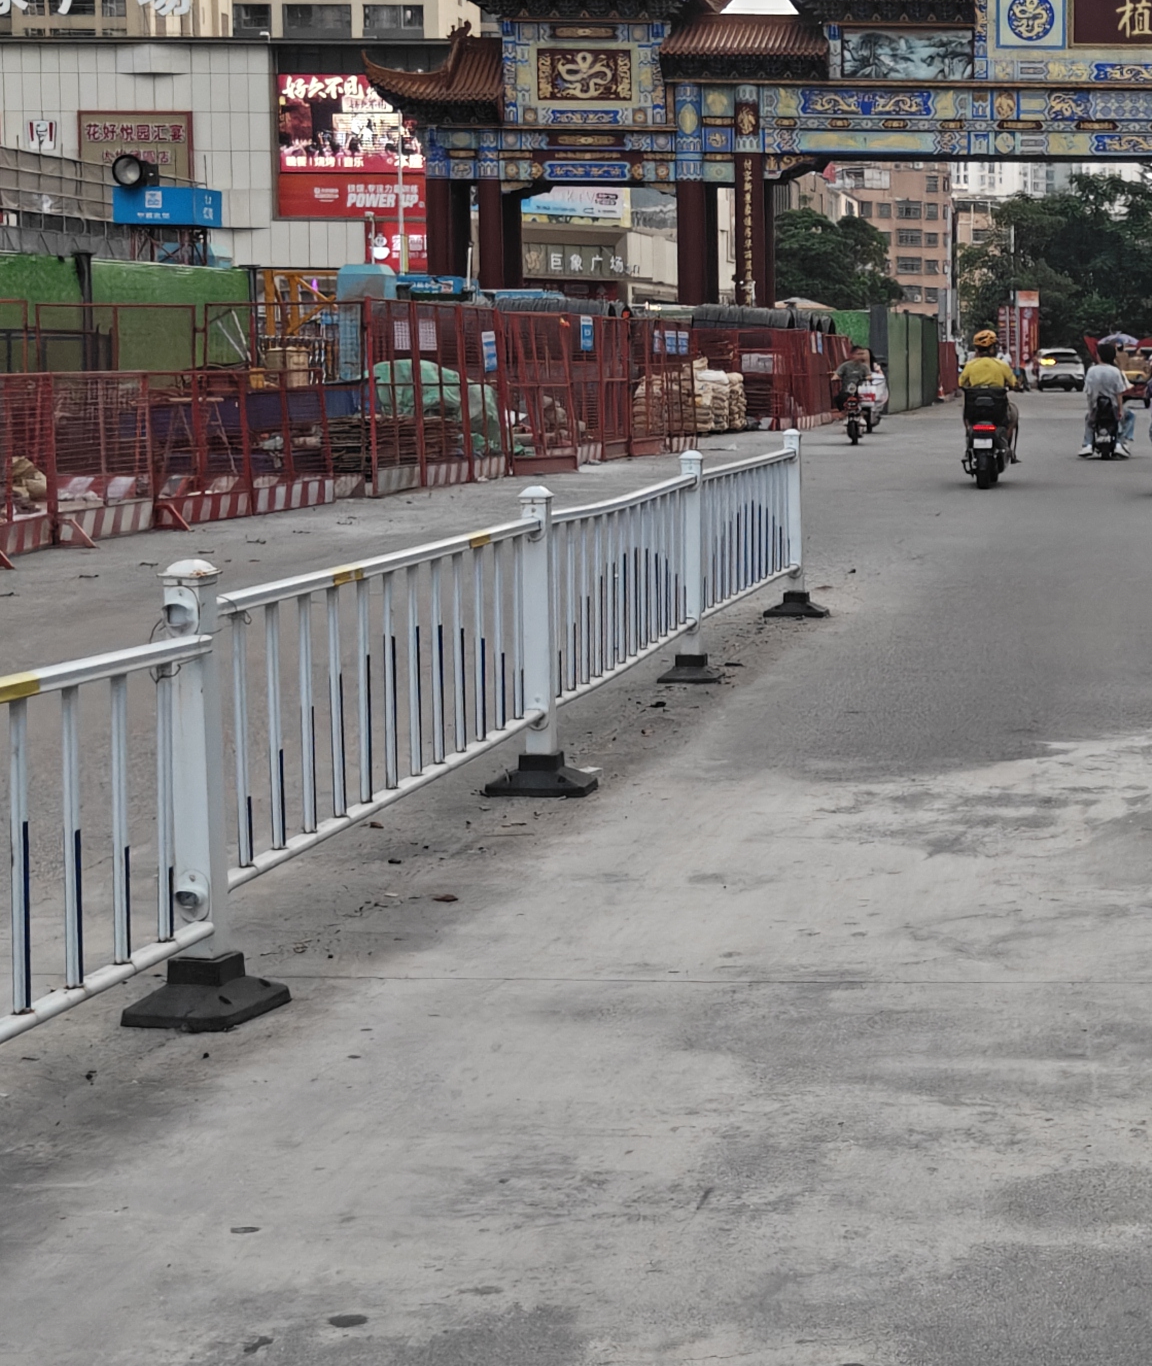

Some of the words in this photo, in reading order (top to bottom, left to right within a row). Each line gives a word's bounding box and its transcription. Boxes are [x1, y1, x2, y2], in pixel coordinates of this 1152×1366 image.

[346, 193, 396, 208] POWER
[550, 252, 624, 273] 巨象广场
